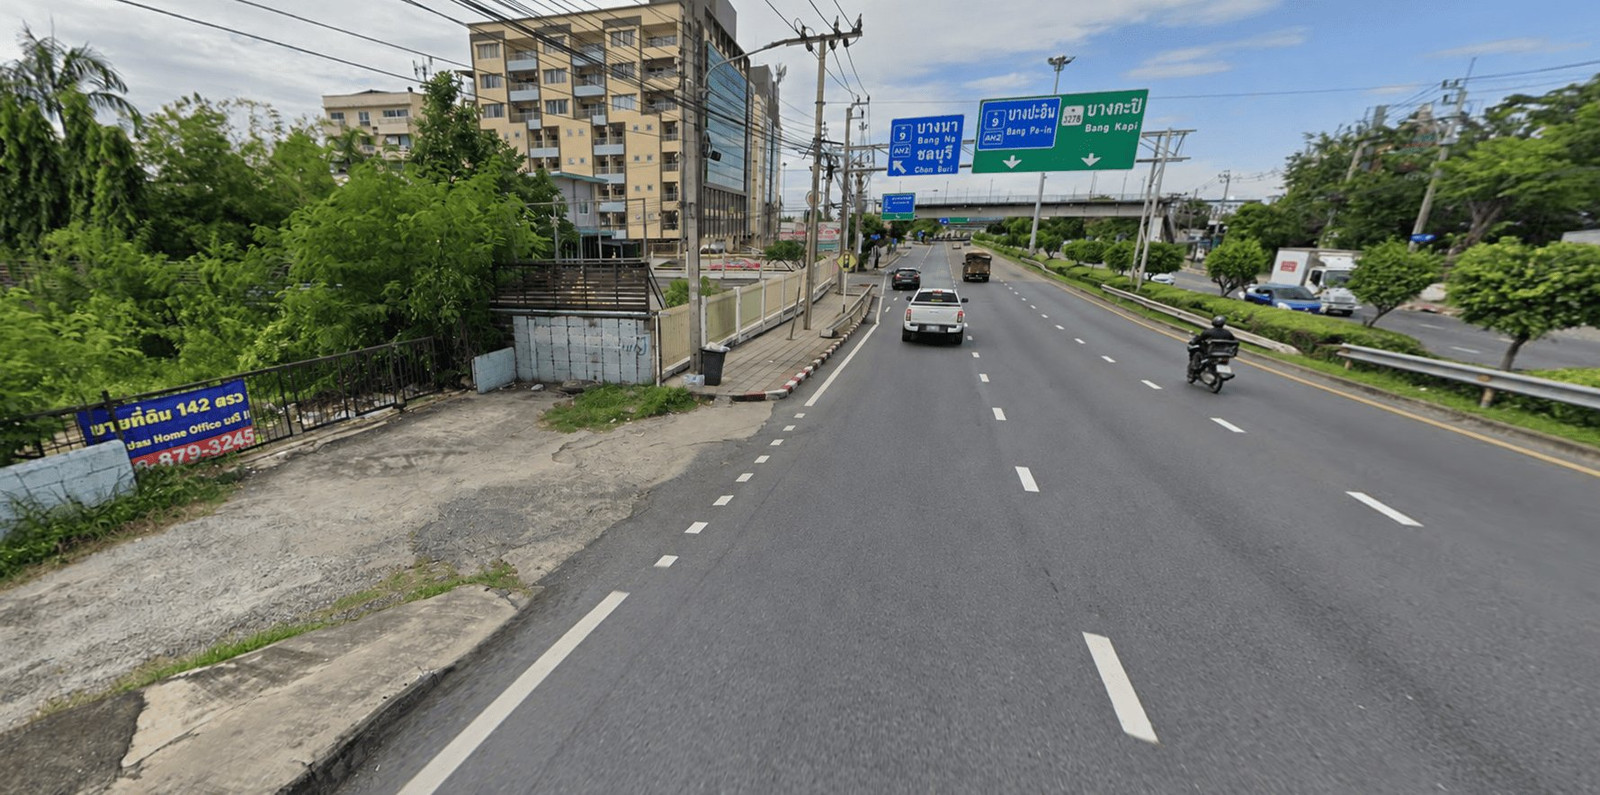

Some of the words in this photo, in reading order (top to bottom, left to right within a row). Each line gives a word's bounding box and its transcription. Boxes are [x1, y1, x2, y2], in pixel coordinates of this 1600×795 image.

[1008, 103, 1055, 120] บางปะอิน
[1087, 98, 1142, 116] บางกะปิ
[992, 118, 999, 127] 9
[1063, 115, 1081, 123] 3278
[917, 121, 958, 134] บางนา
[1006, 127, 1026, 136] Bang
[1030, 125, 1052, 135] Pa-in
[1085, 124, 1109, 133] Bang
[1115, 122, 1138, 132] Kapi
[899, 132, 906, 140] 9
[917, 136, 939, 145] Bang
[944, 135, 956, 143] Na
[917, 145, 953, 164] ชลบุรี
[937, 165, 953, 173] Buri
[176, 398, 211, 416] 142
[153, 430, 187, 444] Home
[189, 421, 222, 434] Office
